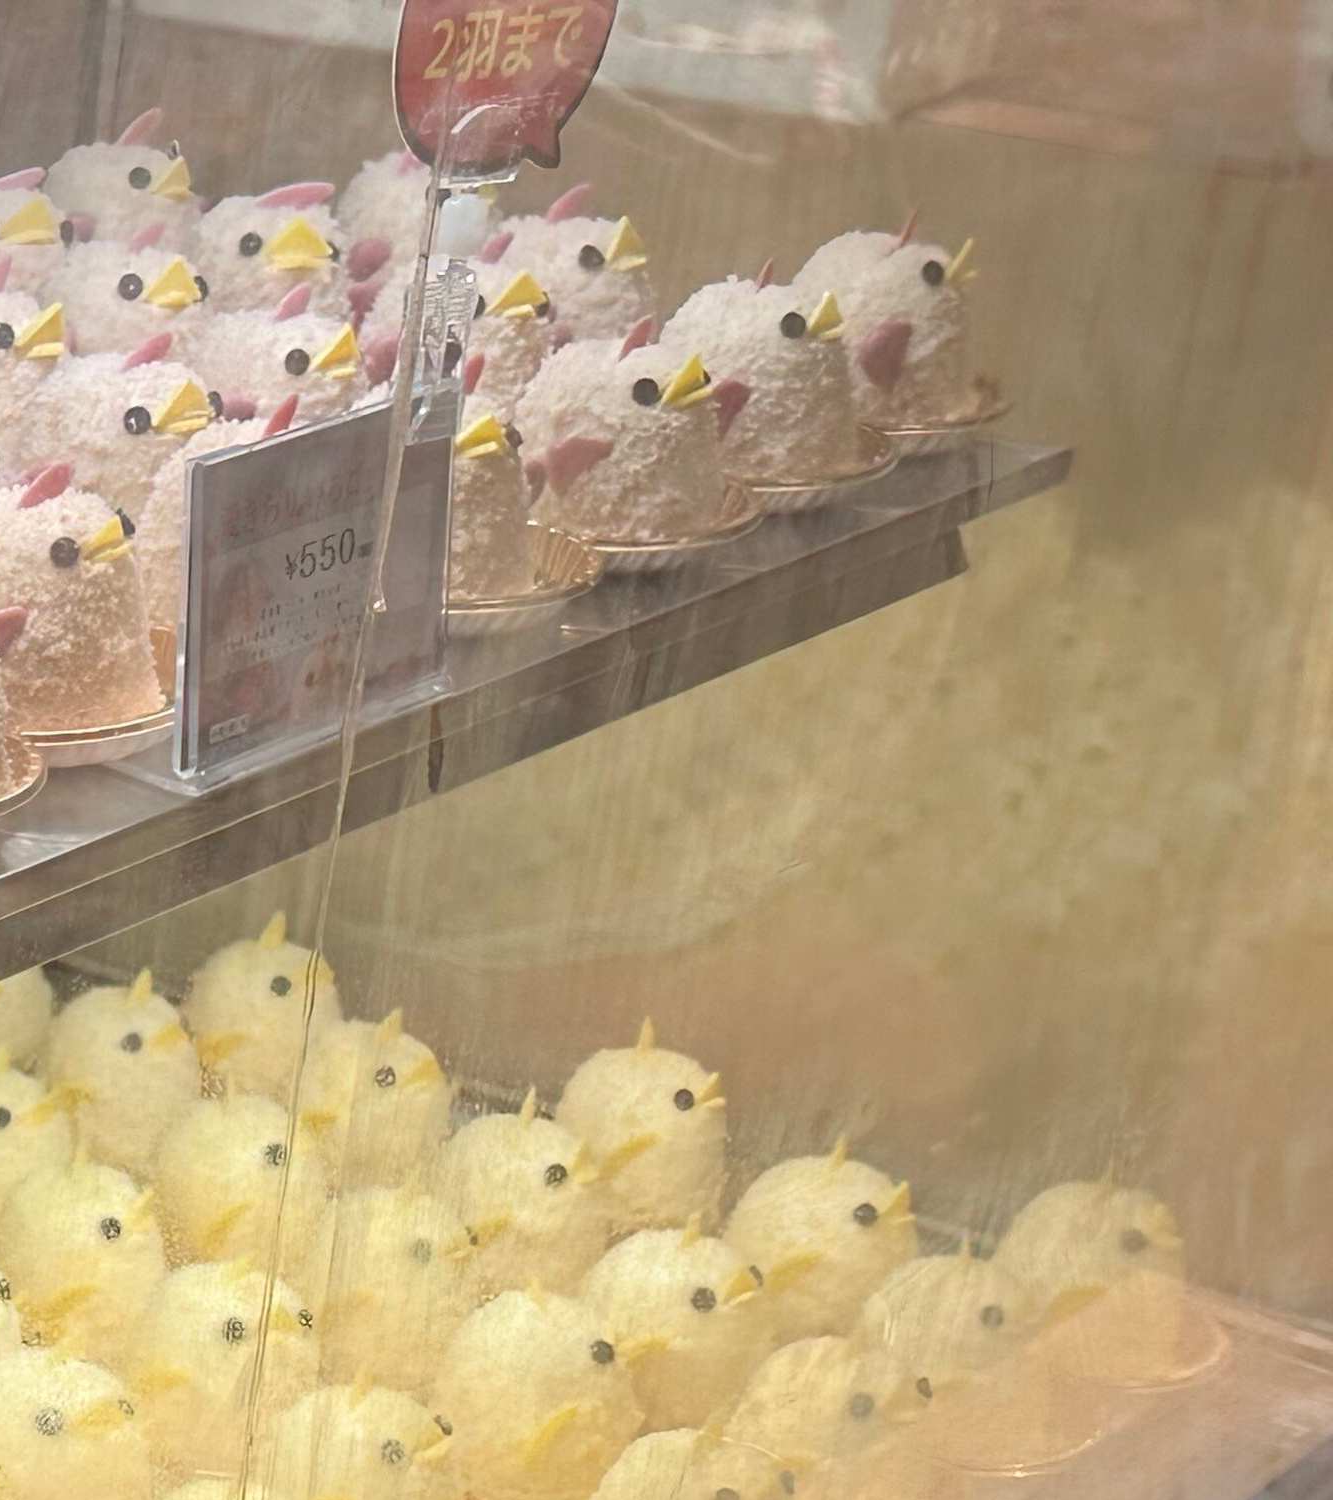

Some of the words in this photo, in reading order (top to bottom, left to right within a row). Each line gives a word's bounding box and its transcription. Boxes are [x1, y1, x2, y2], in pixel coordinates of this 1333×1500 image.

[423, 6, 583, 82] 2羽まで
[285, 528, 356, 581] ¥550
